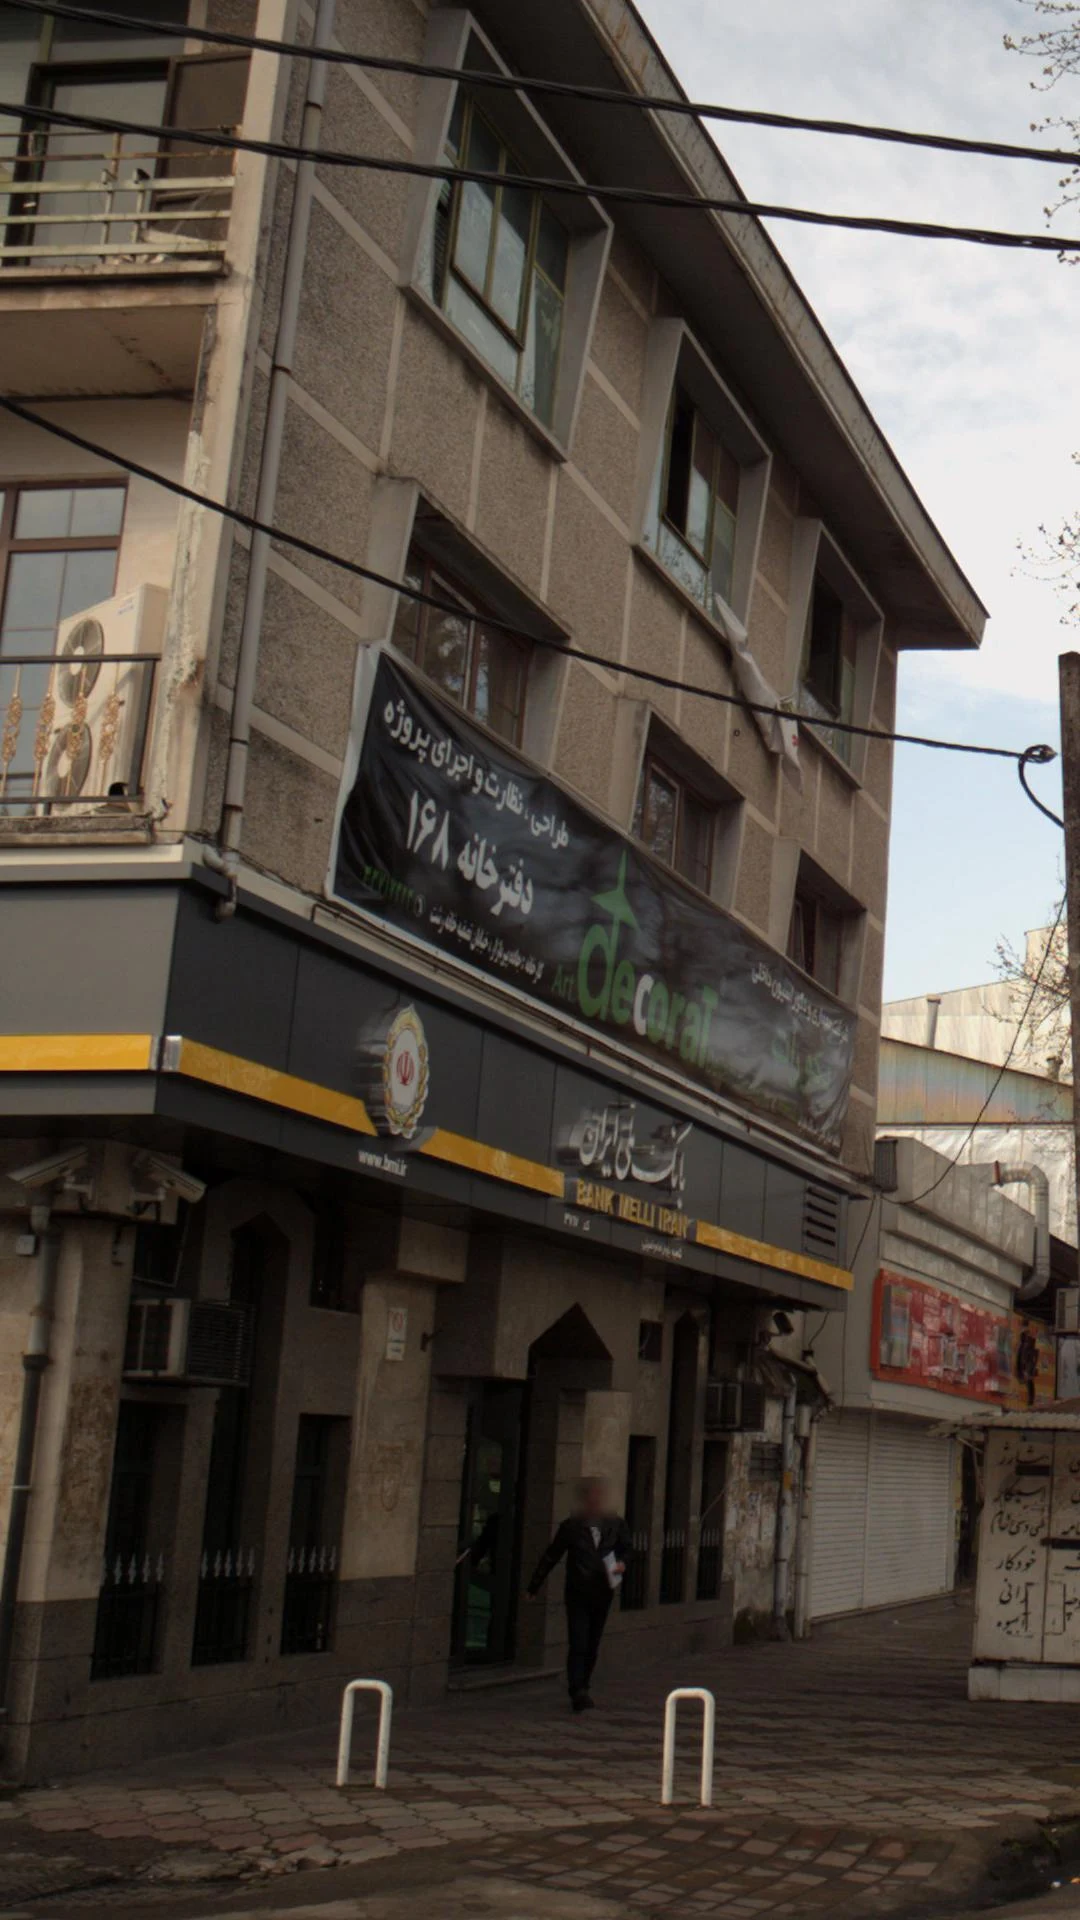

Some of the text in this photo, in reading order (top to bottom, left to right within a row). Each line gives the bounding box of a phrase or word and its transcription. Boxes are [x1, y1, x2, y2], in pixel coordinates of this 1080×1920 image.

[383, 698, 432, 764] پروژه
[430, 738, 475, 782] اجرای
[471, 767, 485, 795] و
[484, 771, 525, 815] نظارت
[407, 790, 450, 872] ۱۶۸
[357, 1147, 409, 1178] www.bmi.ir
[576, 1178, 689, 1239] BANK MELLI IRAN
[996, 1544, 1037, 1572] خودکار
